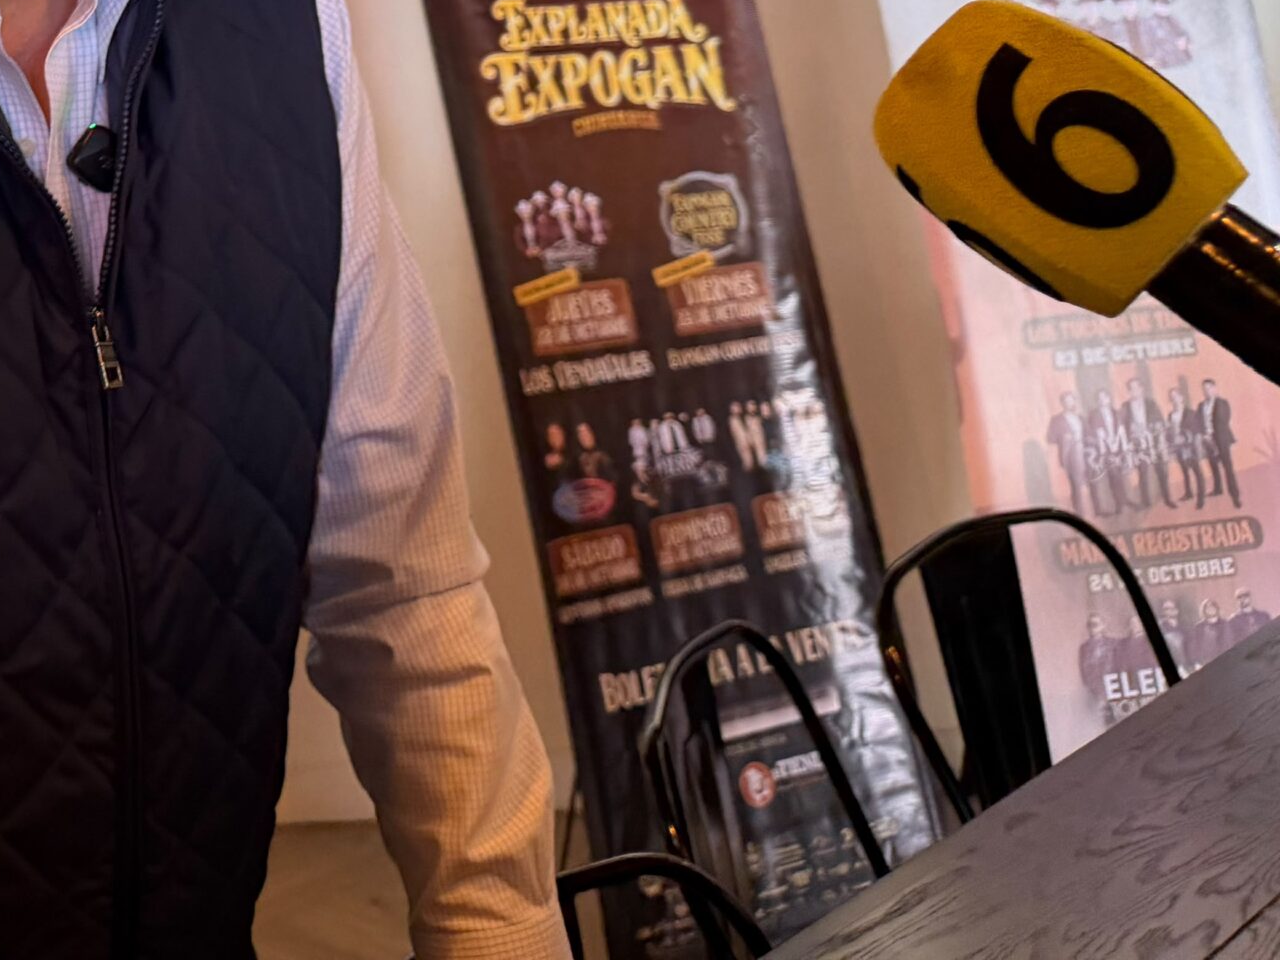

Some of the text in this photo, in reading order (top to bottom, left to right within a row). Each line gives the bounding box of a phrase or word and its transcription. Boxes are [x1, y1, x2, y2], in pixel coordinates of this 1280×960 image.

[480, 37, 737, 126] EXPOGAN
[976, 43, 1175, 229] 6
[1110, 337, 1195, 361] OCTUBRE
[1131, 519, 1255, 557] REGISTRADA
[1089, 572, 1113, 593] 24
[1148, 557, 1236, 585] OCTUBRE
